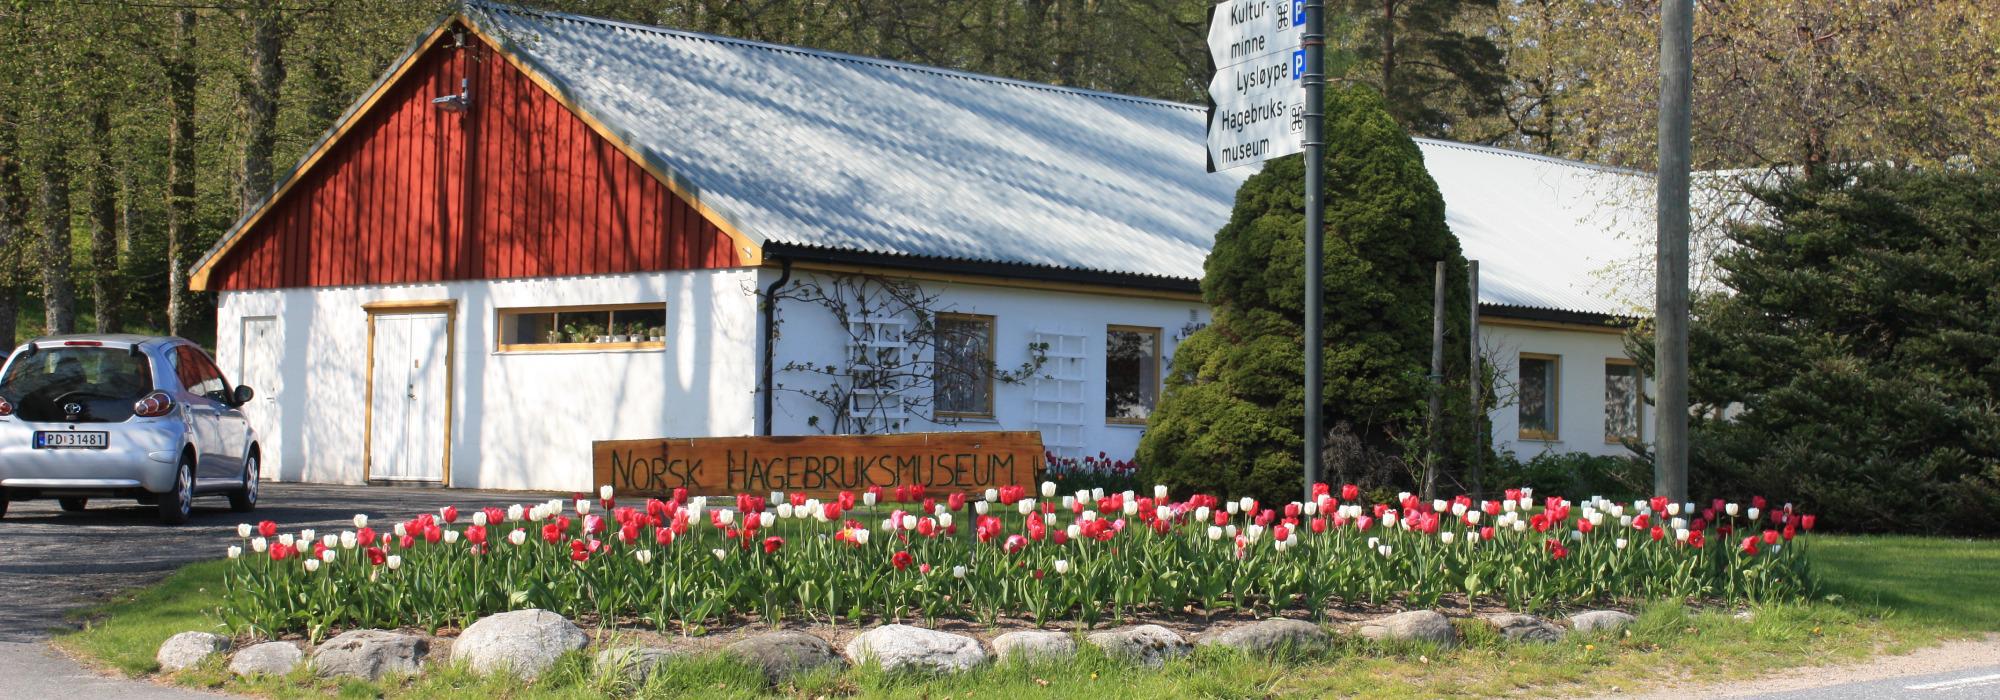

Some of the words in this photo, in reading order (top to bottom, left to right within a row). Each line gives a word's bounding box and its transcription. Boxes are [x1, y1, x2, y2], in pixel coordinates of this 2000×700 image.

[1231, 1, 1269, 26] Kultur-
[1231, 35, 1265, 58] minne
[1295, 54, 1303, 76] P
[1237, 62, 1287, 95] Lysløype
[1222, 98, 1287, 132] Hagebruks-
[1222, 138, 1269, 163] museum
[68, 434, 102, 445] 31481
[612, 449, 703, 491] NORSK
